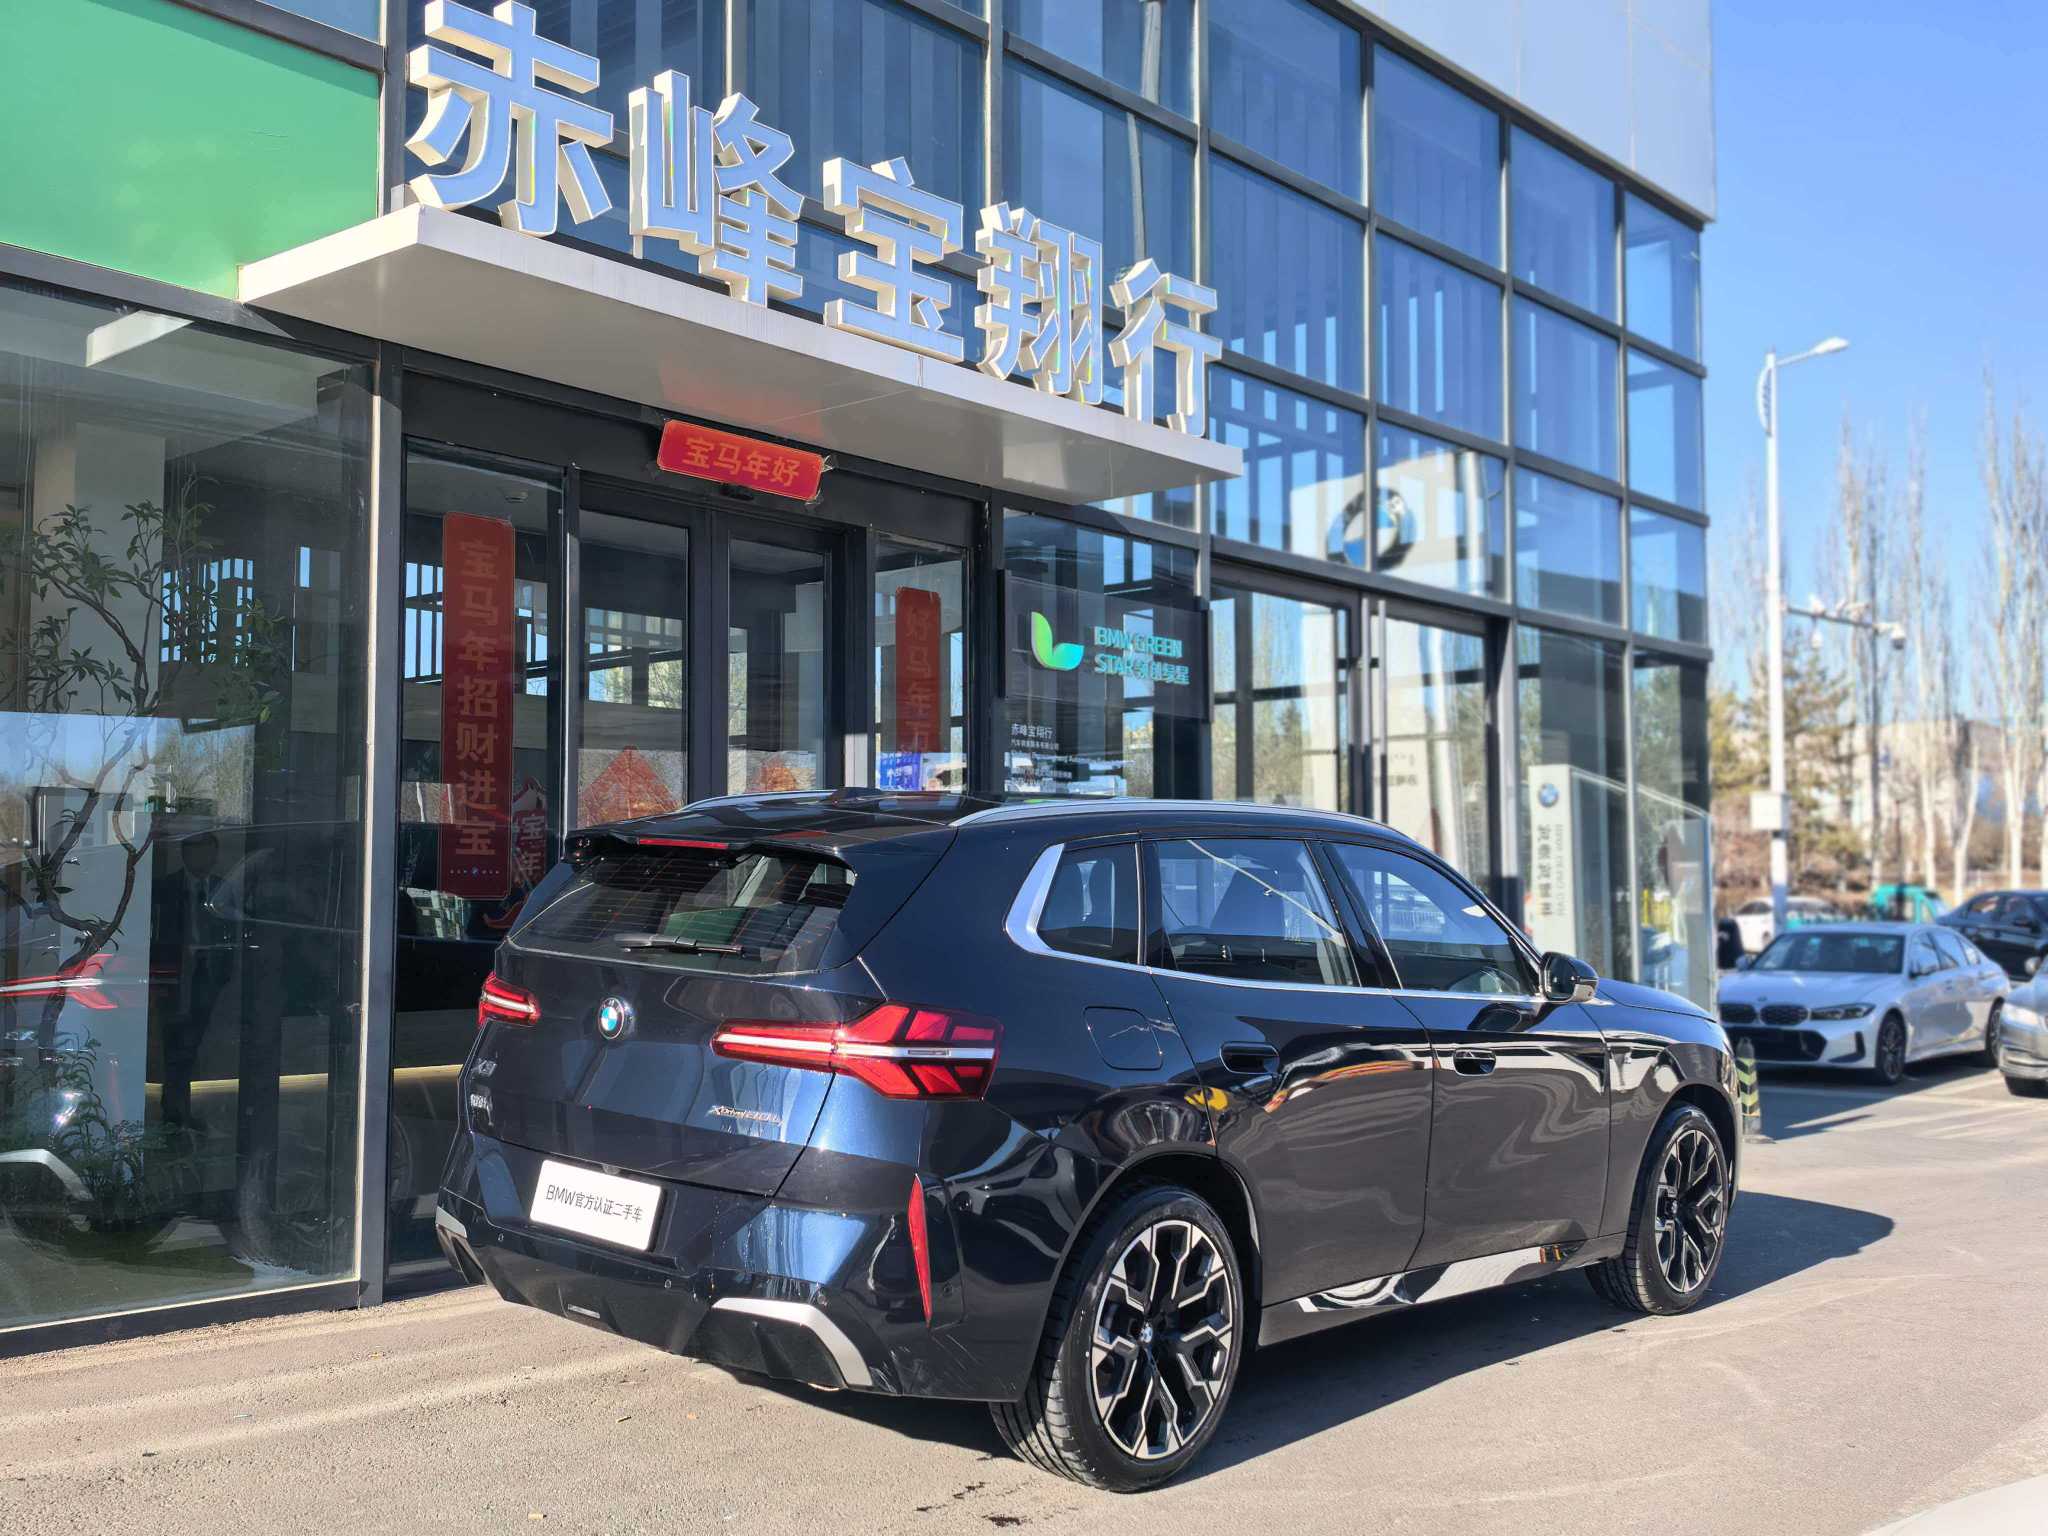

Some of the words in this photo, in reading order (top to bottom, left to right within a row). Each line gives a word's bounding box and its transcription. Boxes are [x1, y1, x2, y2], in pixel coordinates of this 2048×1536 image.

[406, 0, 1223, 437] 赤峰宝翔行
[682, 436, 801, 487] 宝马年好
[1094, 626, 1133, 650] BMW
[1134, 632, 1183, 658] GREEN
[1094, 653, 1133, 676] STAR
[456, 539, 500, 857] 宝马年招财进宝
[545, 1184, 644, 1223] BMW官方认证二手车
